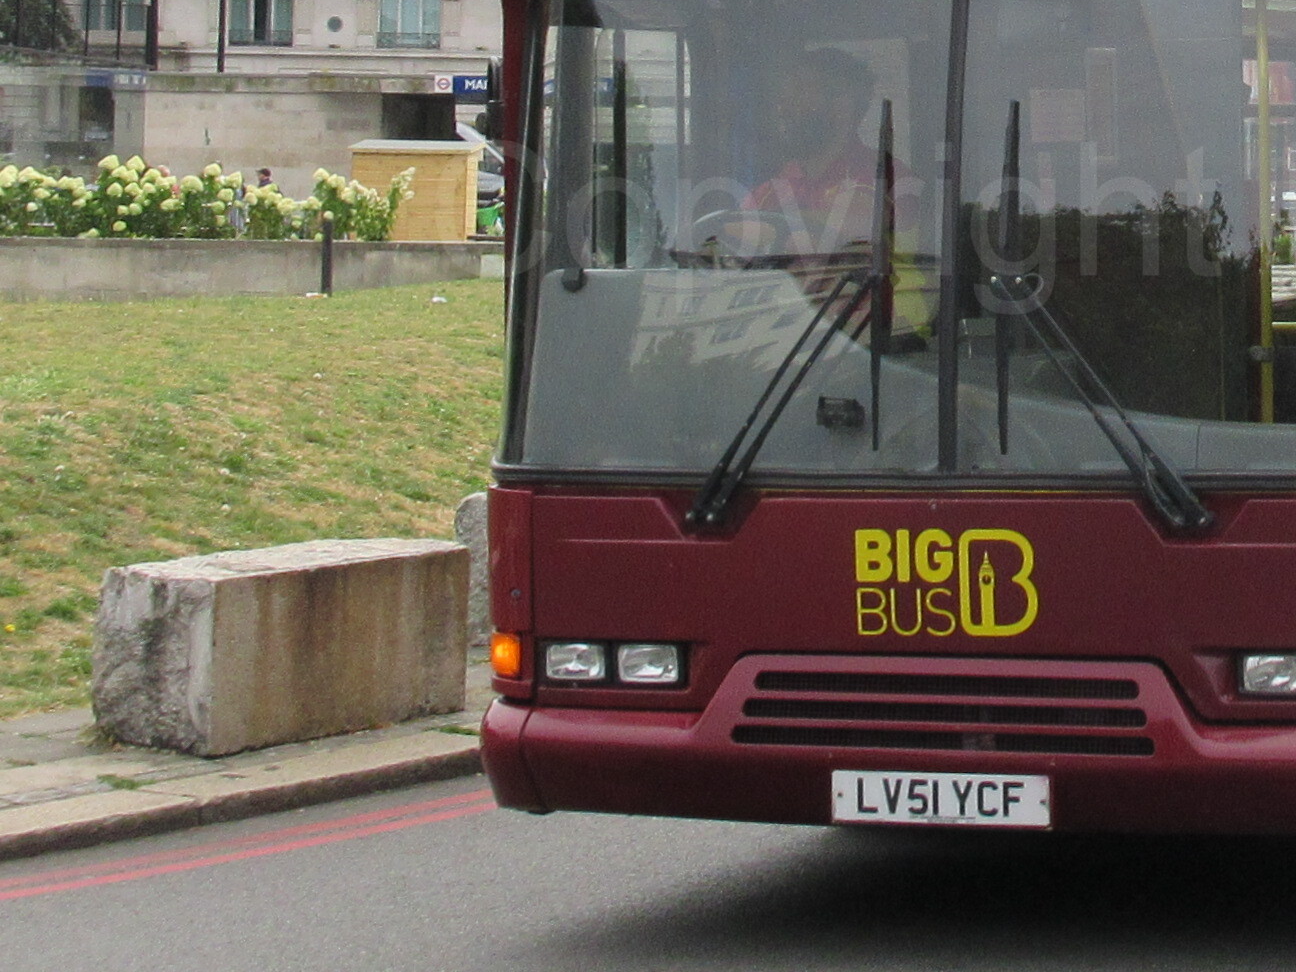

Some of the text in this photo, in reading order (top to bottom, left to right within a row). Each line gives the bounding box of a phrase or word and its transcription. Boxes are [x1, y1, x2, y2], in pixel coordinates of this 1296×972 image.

[855, 529, 954, 582] BIG
[856, 588, 957, 636] BUS
[856, 778, 1025, 817] LV51 YCF
